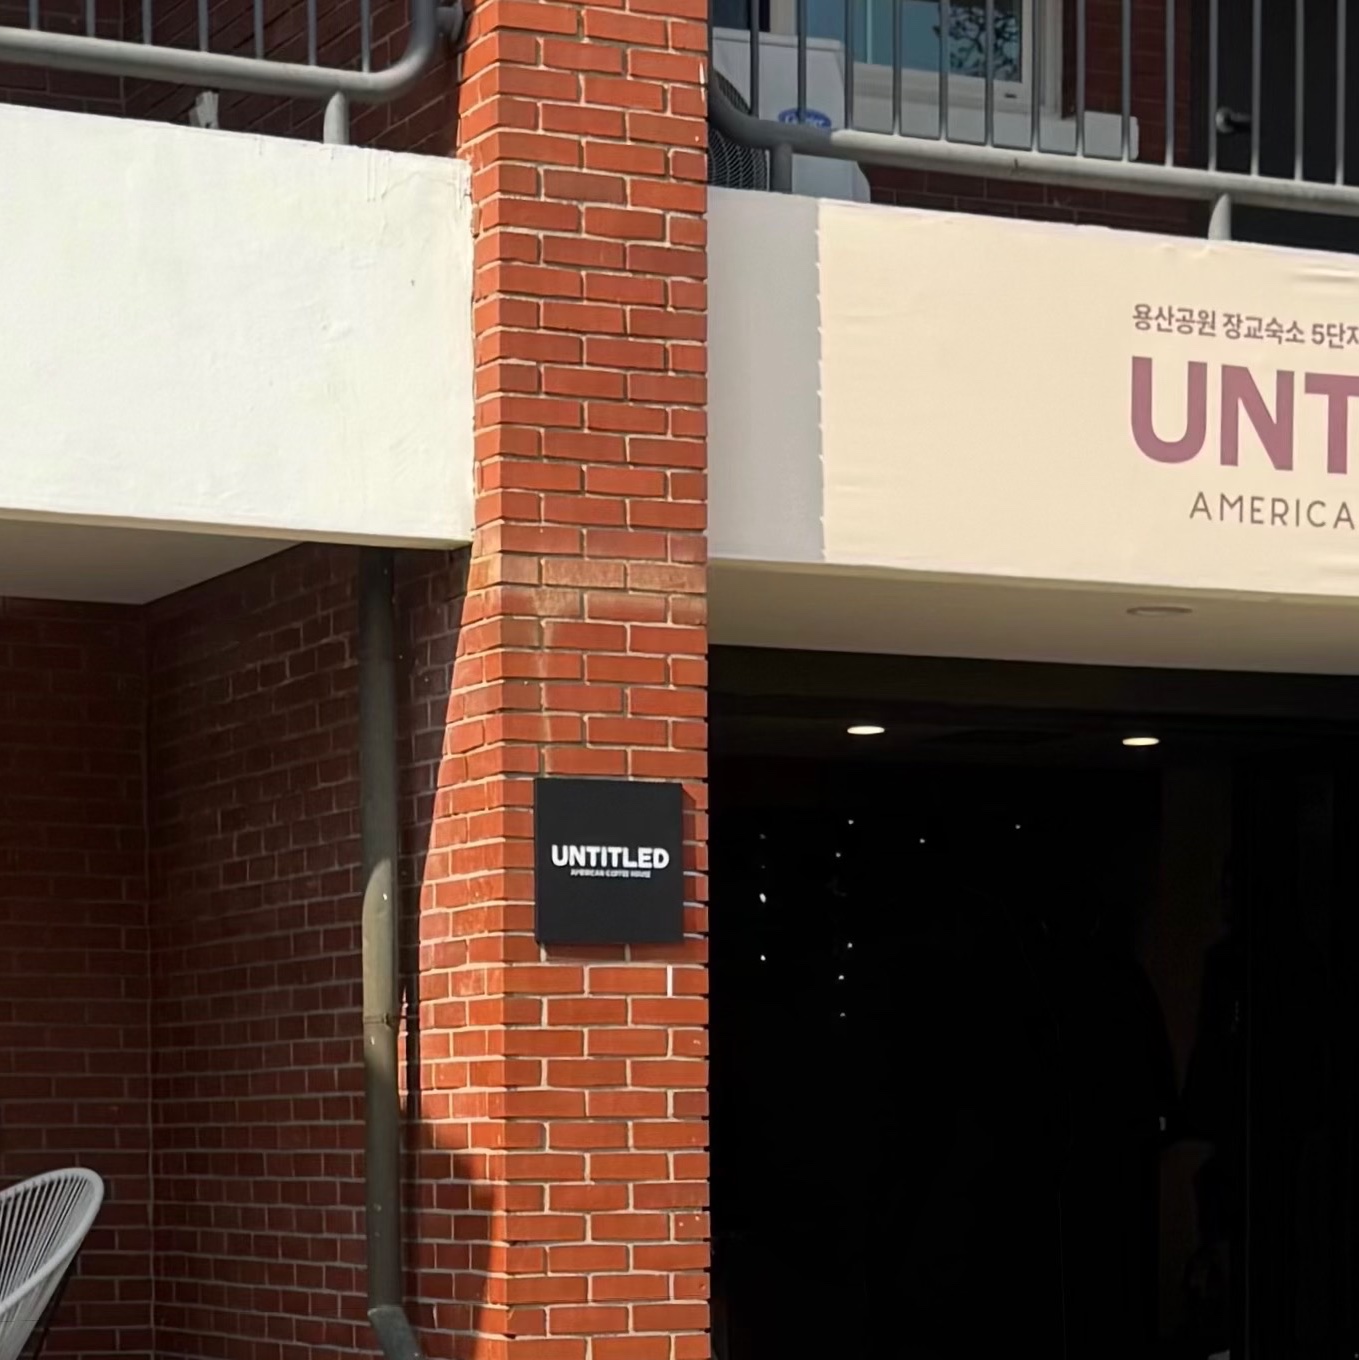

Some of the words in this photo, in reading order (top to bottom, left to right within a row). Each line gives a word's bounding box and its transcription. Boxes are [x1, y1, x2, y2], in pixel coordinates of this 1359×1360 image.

[1132, 303, 1217, 338] 용산공원
[1222, 312, 1306, 345] 장교숙소
[551, 844, 670, 870] UNTITLED
